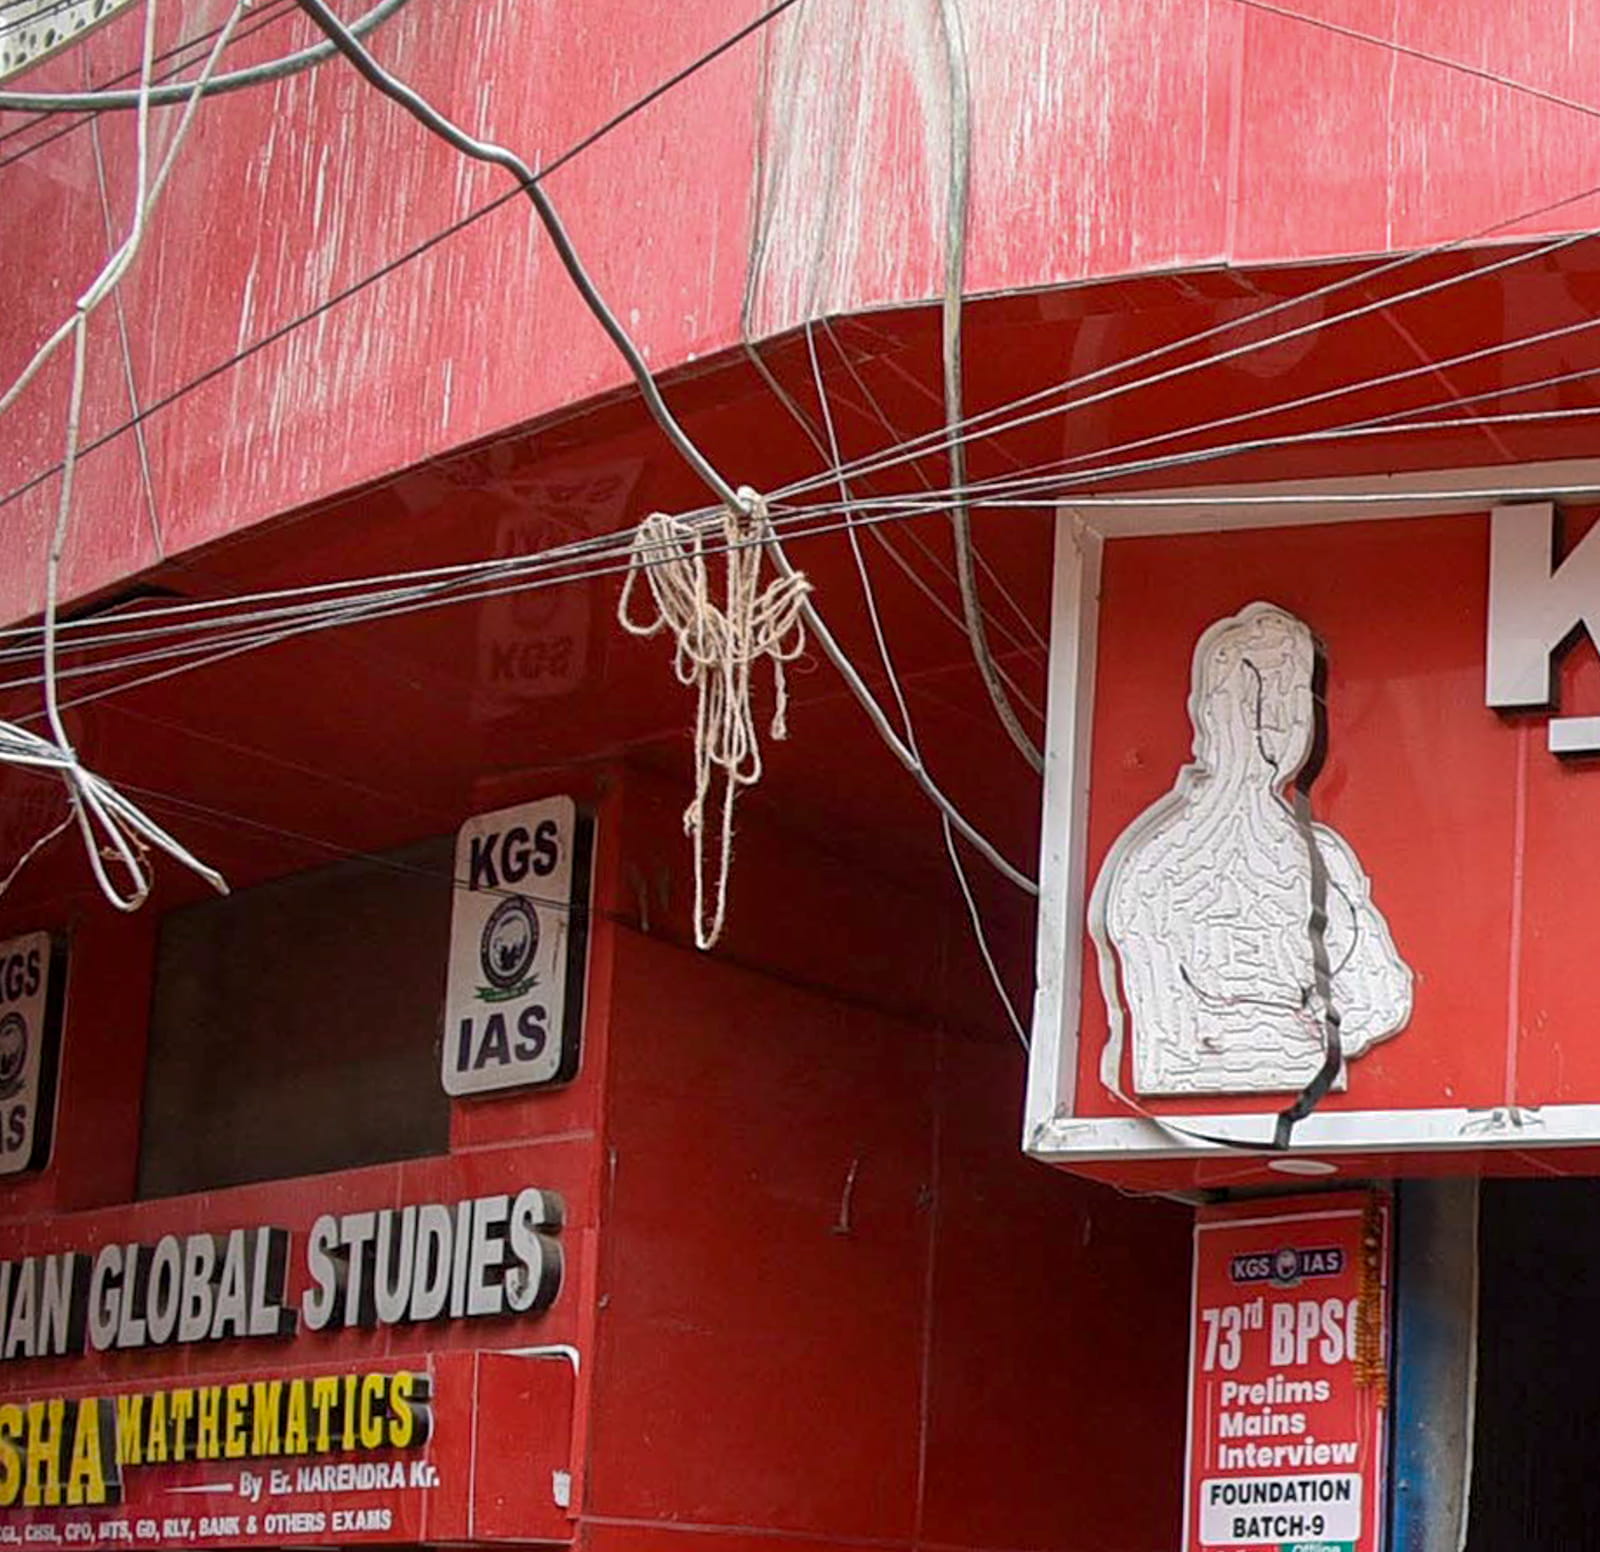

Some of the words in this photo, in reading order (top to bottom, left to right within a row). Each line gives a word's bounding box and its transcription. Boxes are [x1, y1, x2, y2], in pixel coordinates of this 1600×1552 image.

[469, 819, 558, 891] KGS
[456, 1004, 547, 1073] IAS
[0, 1252, 74, 1357] AN
[88, 1227, 292, 1351] GLOBAL
[304, 1187, 550, 1332] STUDIES
[1234, 1257, 1270, 1279] KGS
[1303, 1252, 1340, 1273] IAS
[1221, 1374, 1331, 1406] Prelims
[116, 1370, 414, 1466] MATHEMATICS
[1219, 1407, 1306, 1438] Mains
[1218, 1436, 1359, 1470] Interview
[238, 1470, 263, 1502] By
[269, 1469, 292, 1494] Er.
[297, 1462, 406, 1494] NARENDRA
[409, 1460, 441, 1489] Kr.
[1210, 1479, 1351, 1506] FOUNDATION
[264, 1511, 326, 1534] OTHERS
[331, 1509, 392, 1531] EXAMS
[1232, 1515, 1325, 1538] BATCH-9
